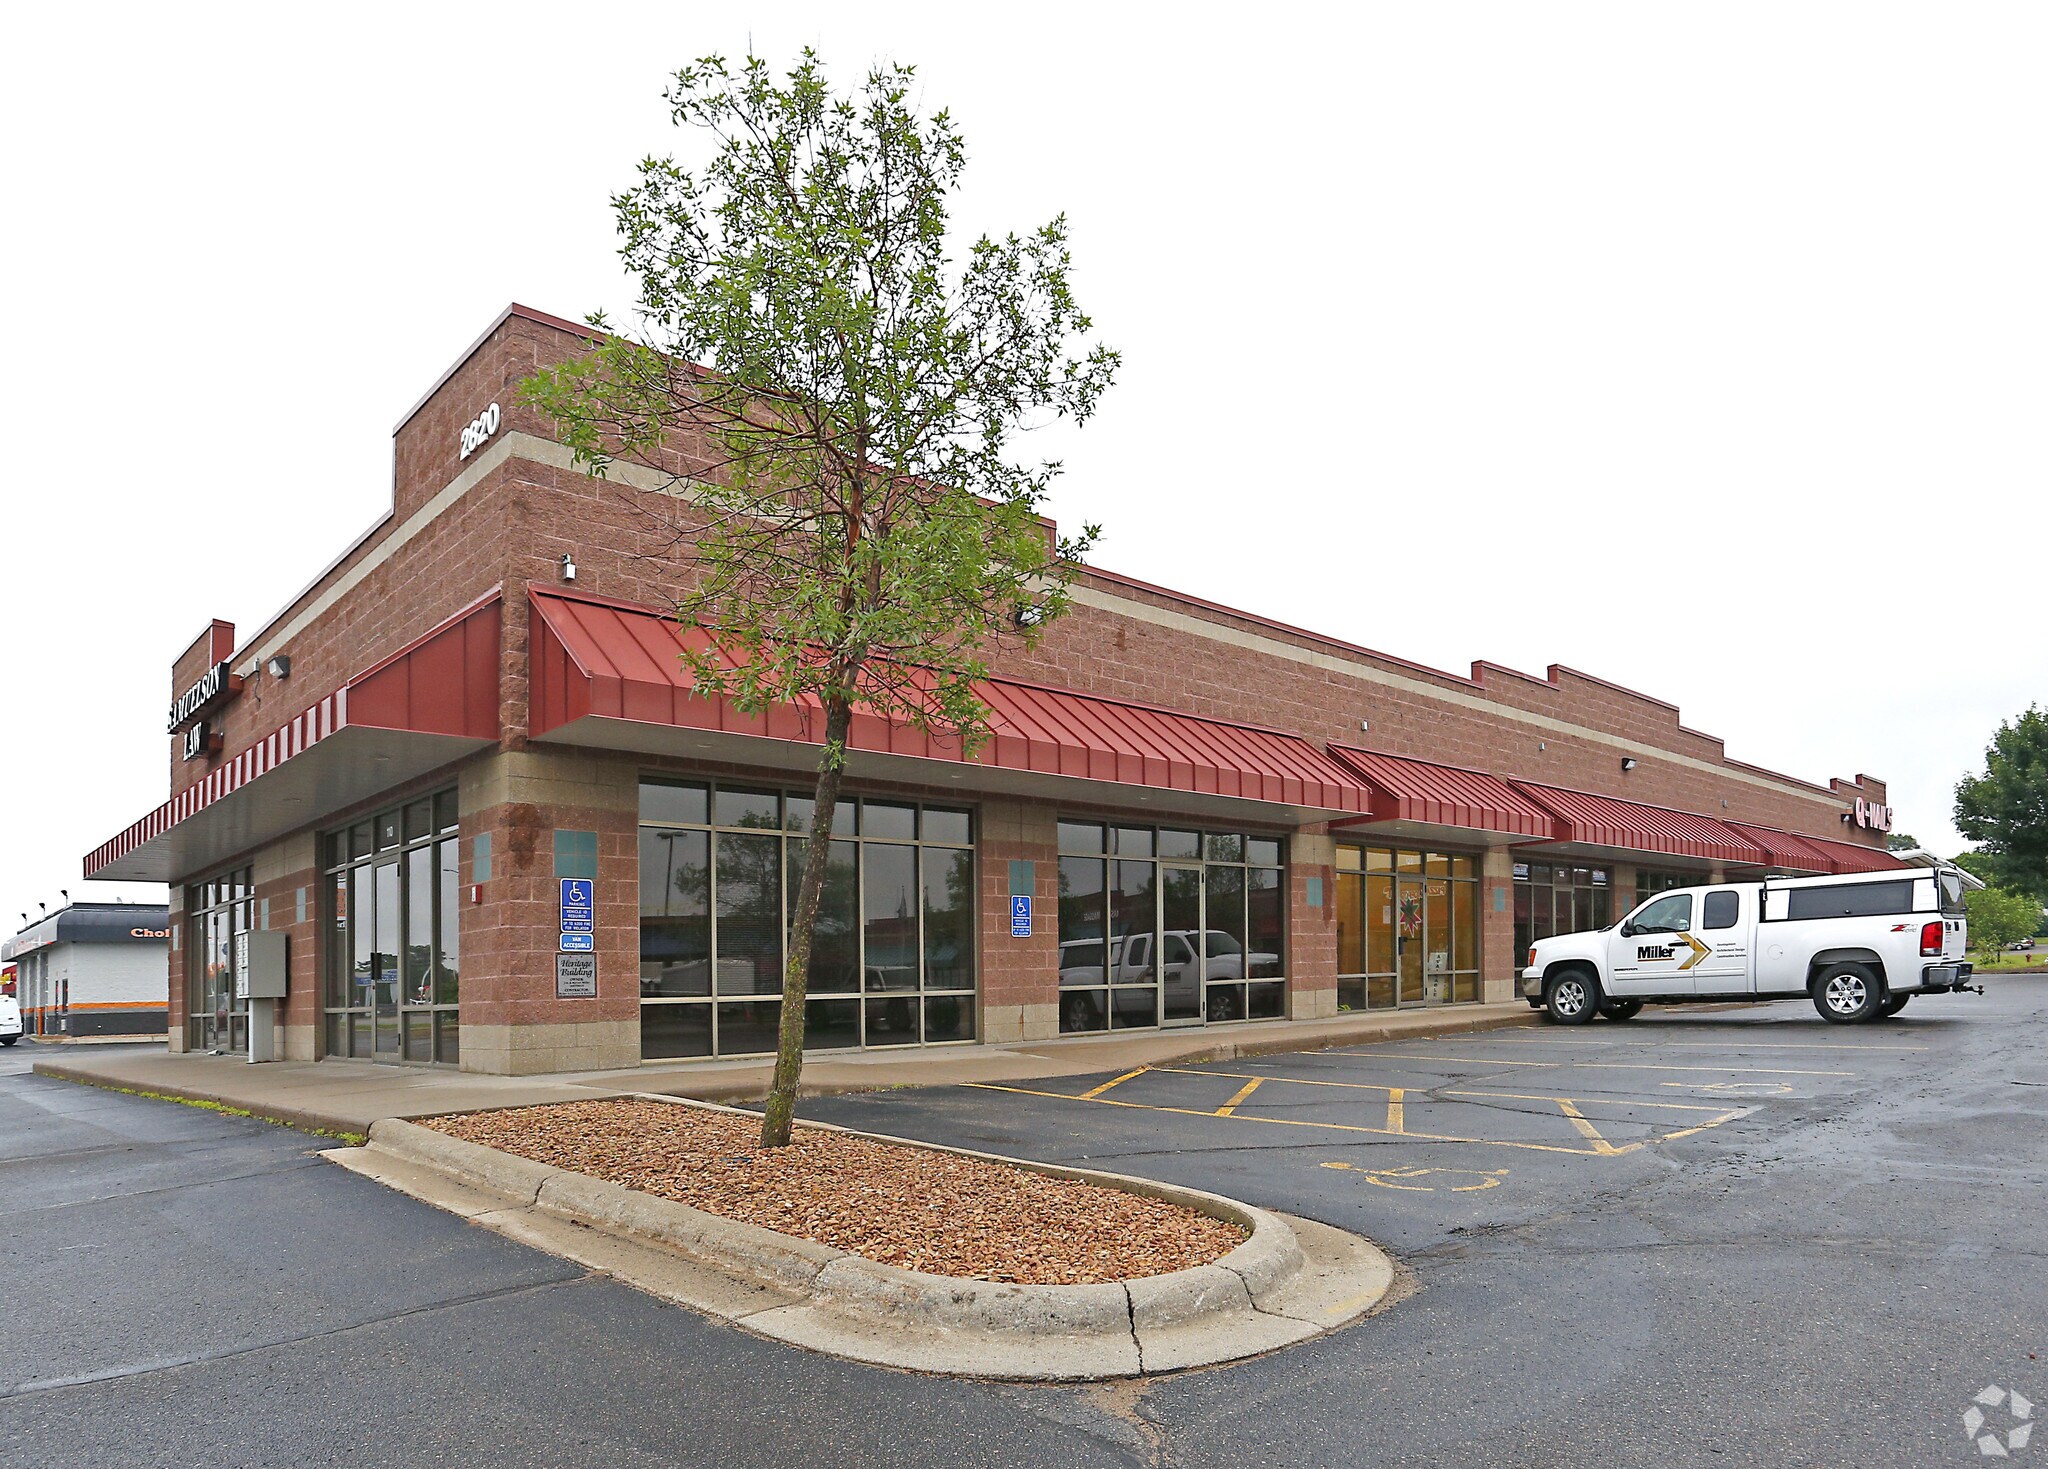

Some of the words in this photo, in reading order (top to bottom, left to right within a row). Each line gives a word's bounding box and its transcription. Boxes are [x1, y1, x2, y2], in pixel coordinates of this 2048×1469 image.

[460, 402, 501, 461] 2820
[168, 662, 221, 733] SAMUELSON
[183, 722, 202, 761] LAW
[560, 959, 593, 969] Heritage
[1637, 946, 1675, 959] Miller
[560, 968, 593, 978] Building
